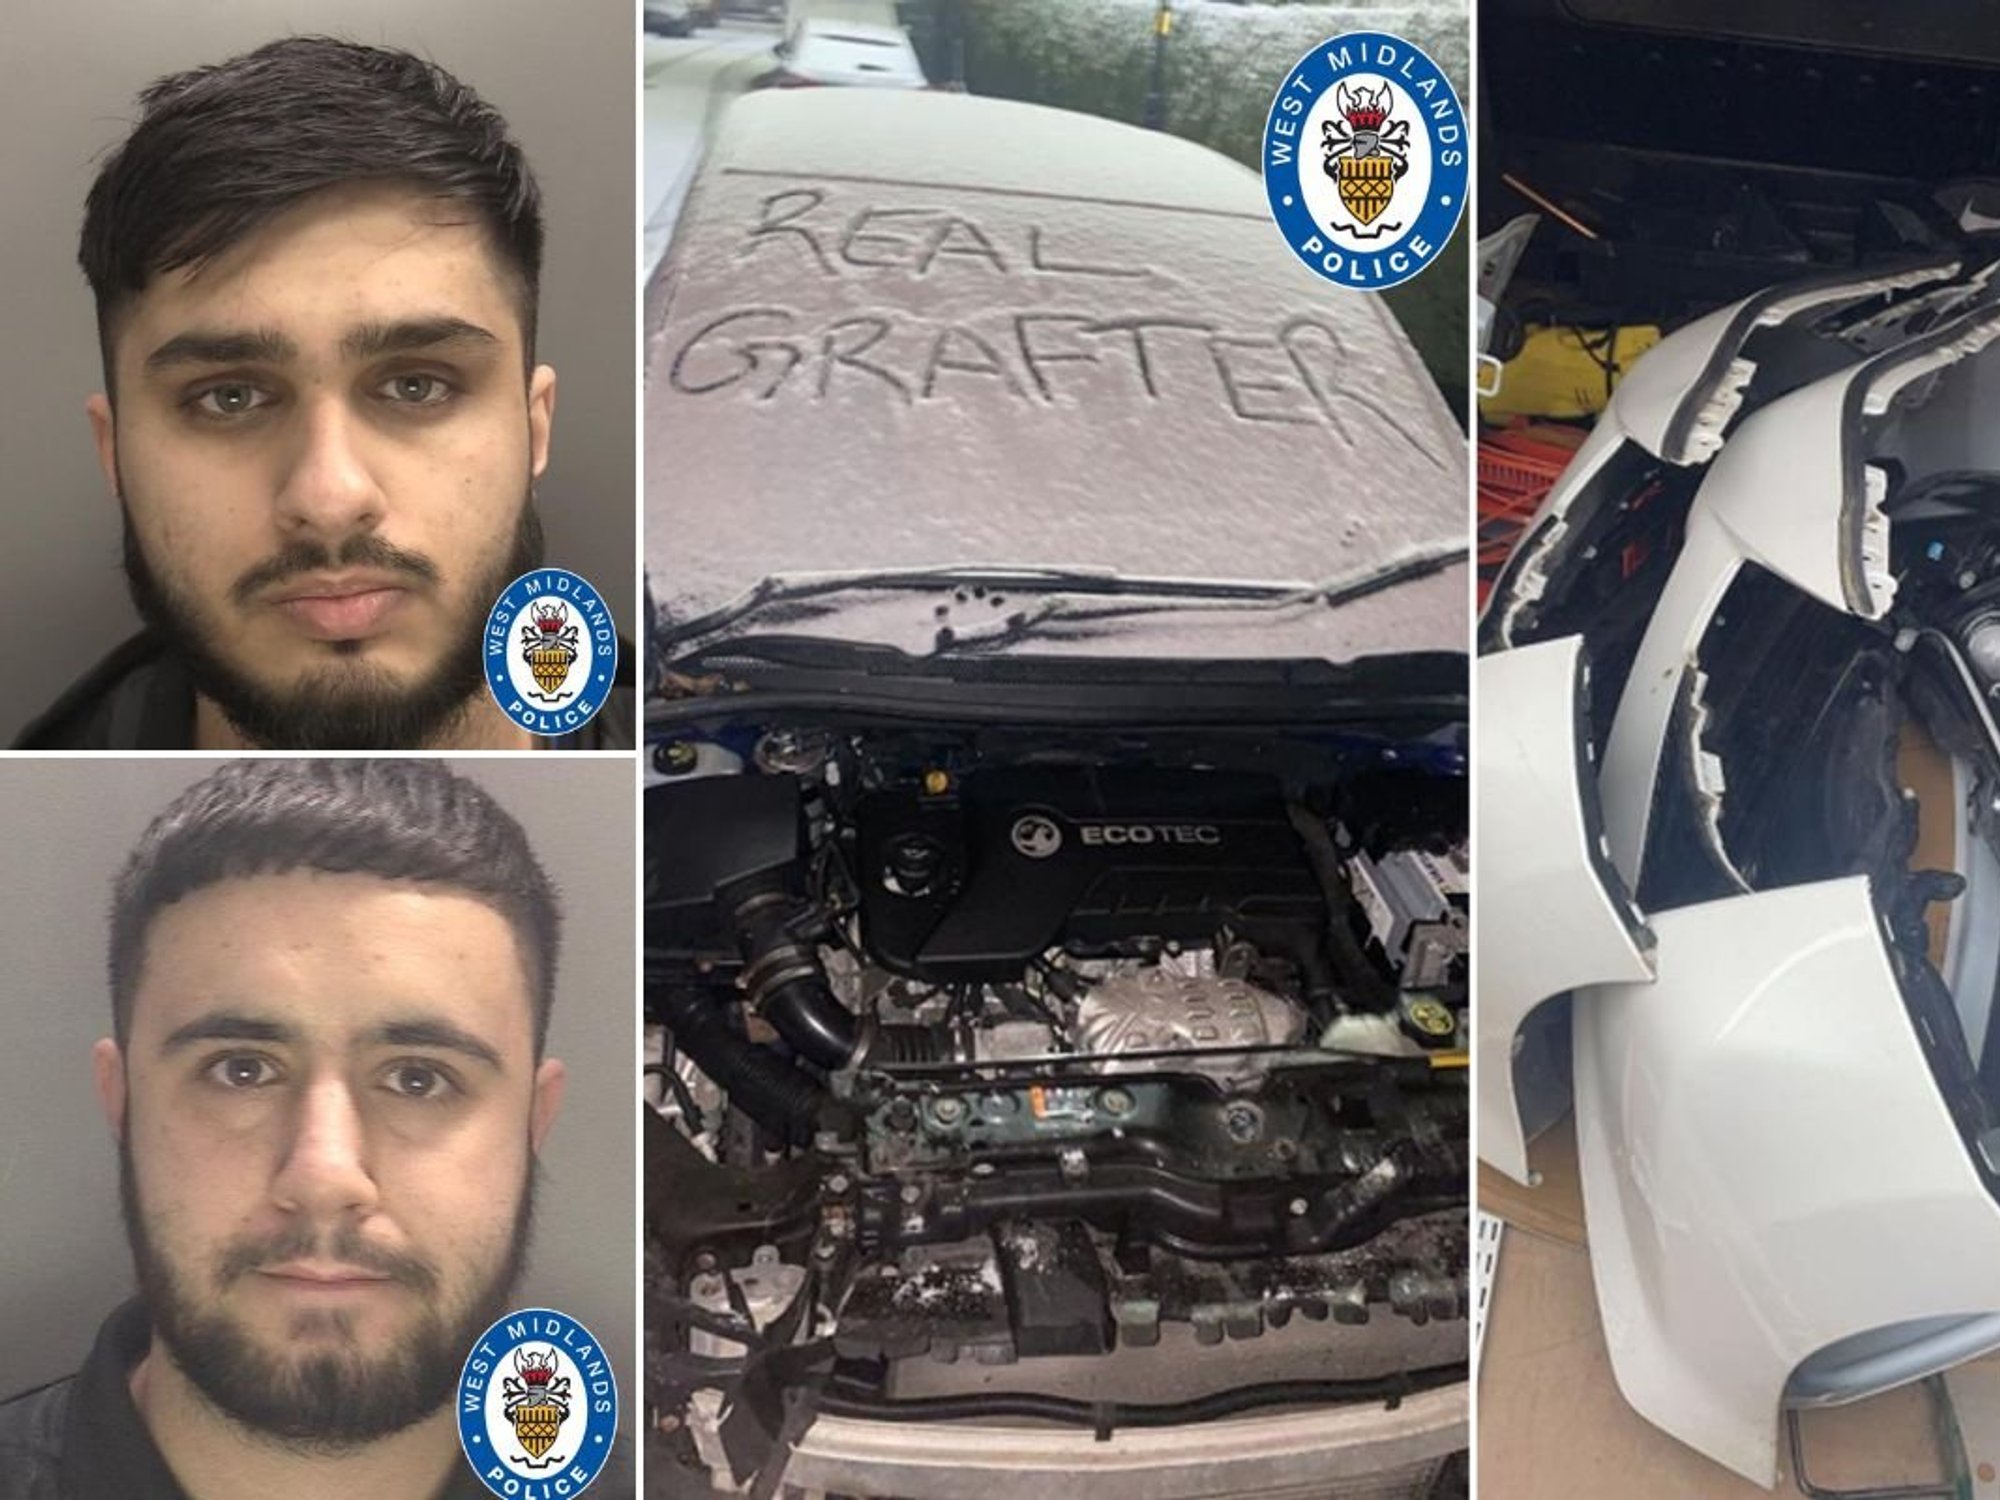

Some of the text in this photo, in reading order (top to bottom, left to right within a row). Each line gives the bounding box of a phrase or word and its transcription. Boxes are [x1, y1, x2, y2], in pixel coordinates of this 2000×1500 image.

[738, 188, 1153, 278] REAL
[669, 309, 1448, 472] GRAFTER
[1079, 824, 1221, 845] ECOTEC
